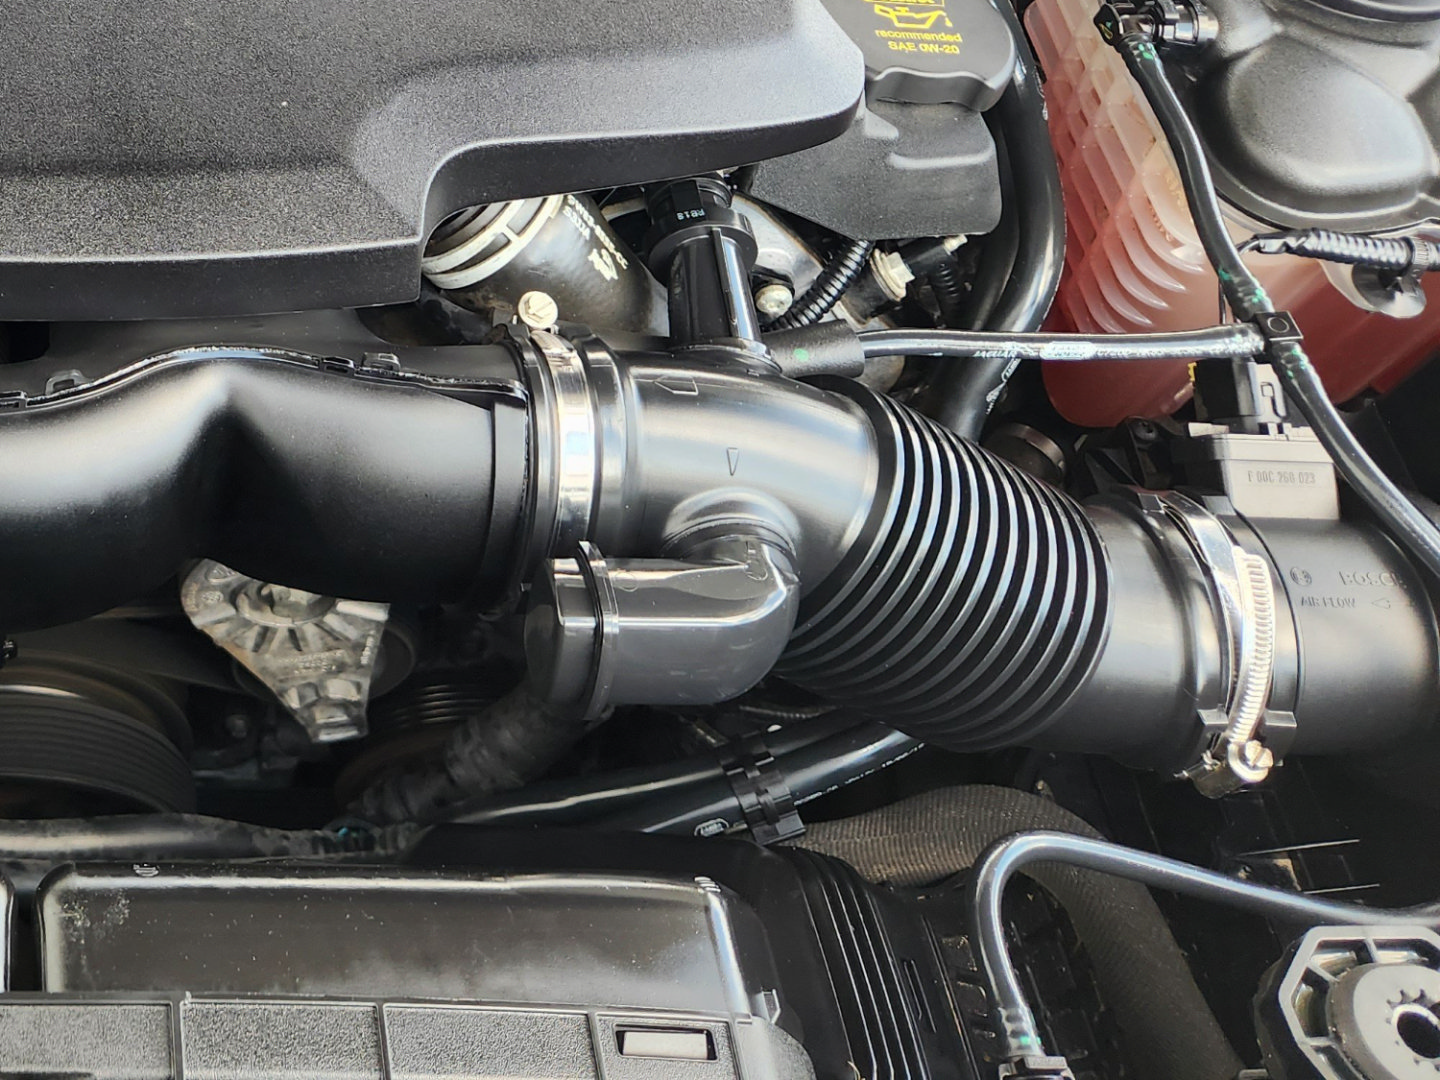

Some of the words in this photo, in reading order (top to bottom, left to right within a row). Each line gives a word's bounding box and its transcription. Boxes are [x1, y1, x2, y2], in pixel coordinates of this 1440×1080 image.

[874, 29, 963, 43] recommended
[888, 41, 917, 52] SAE
[919, 43, 960, 55] 0W-20
